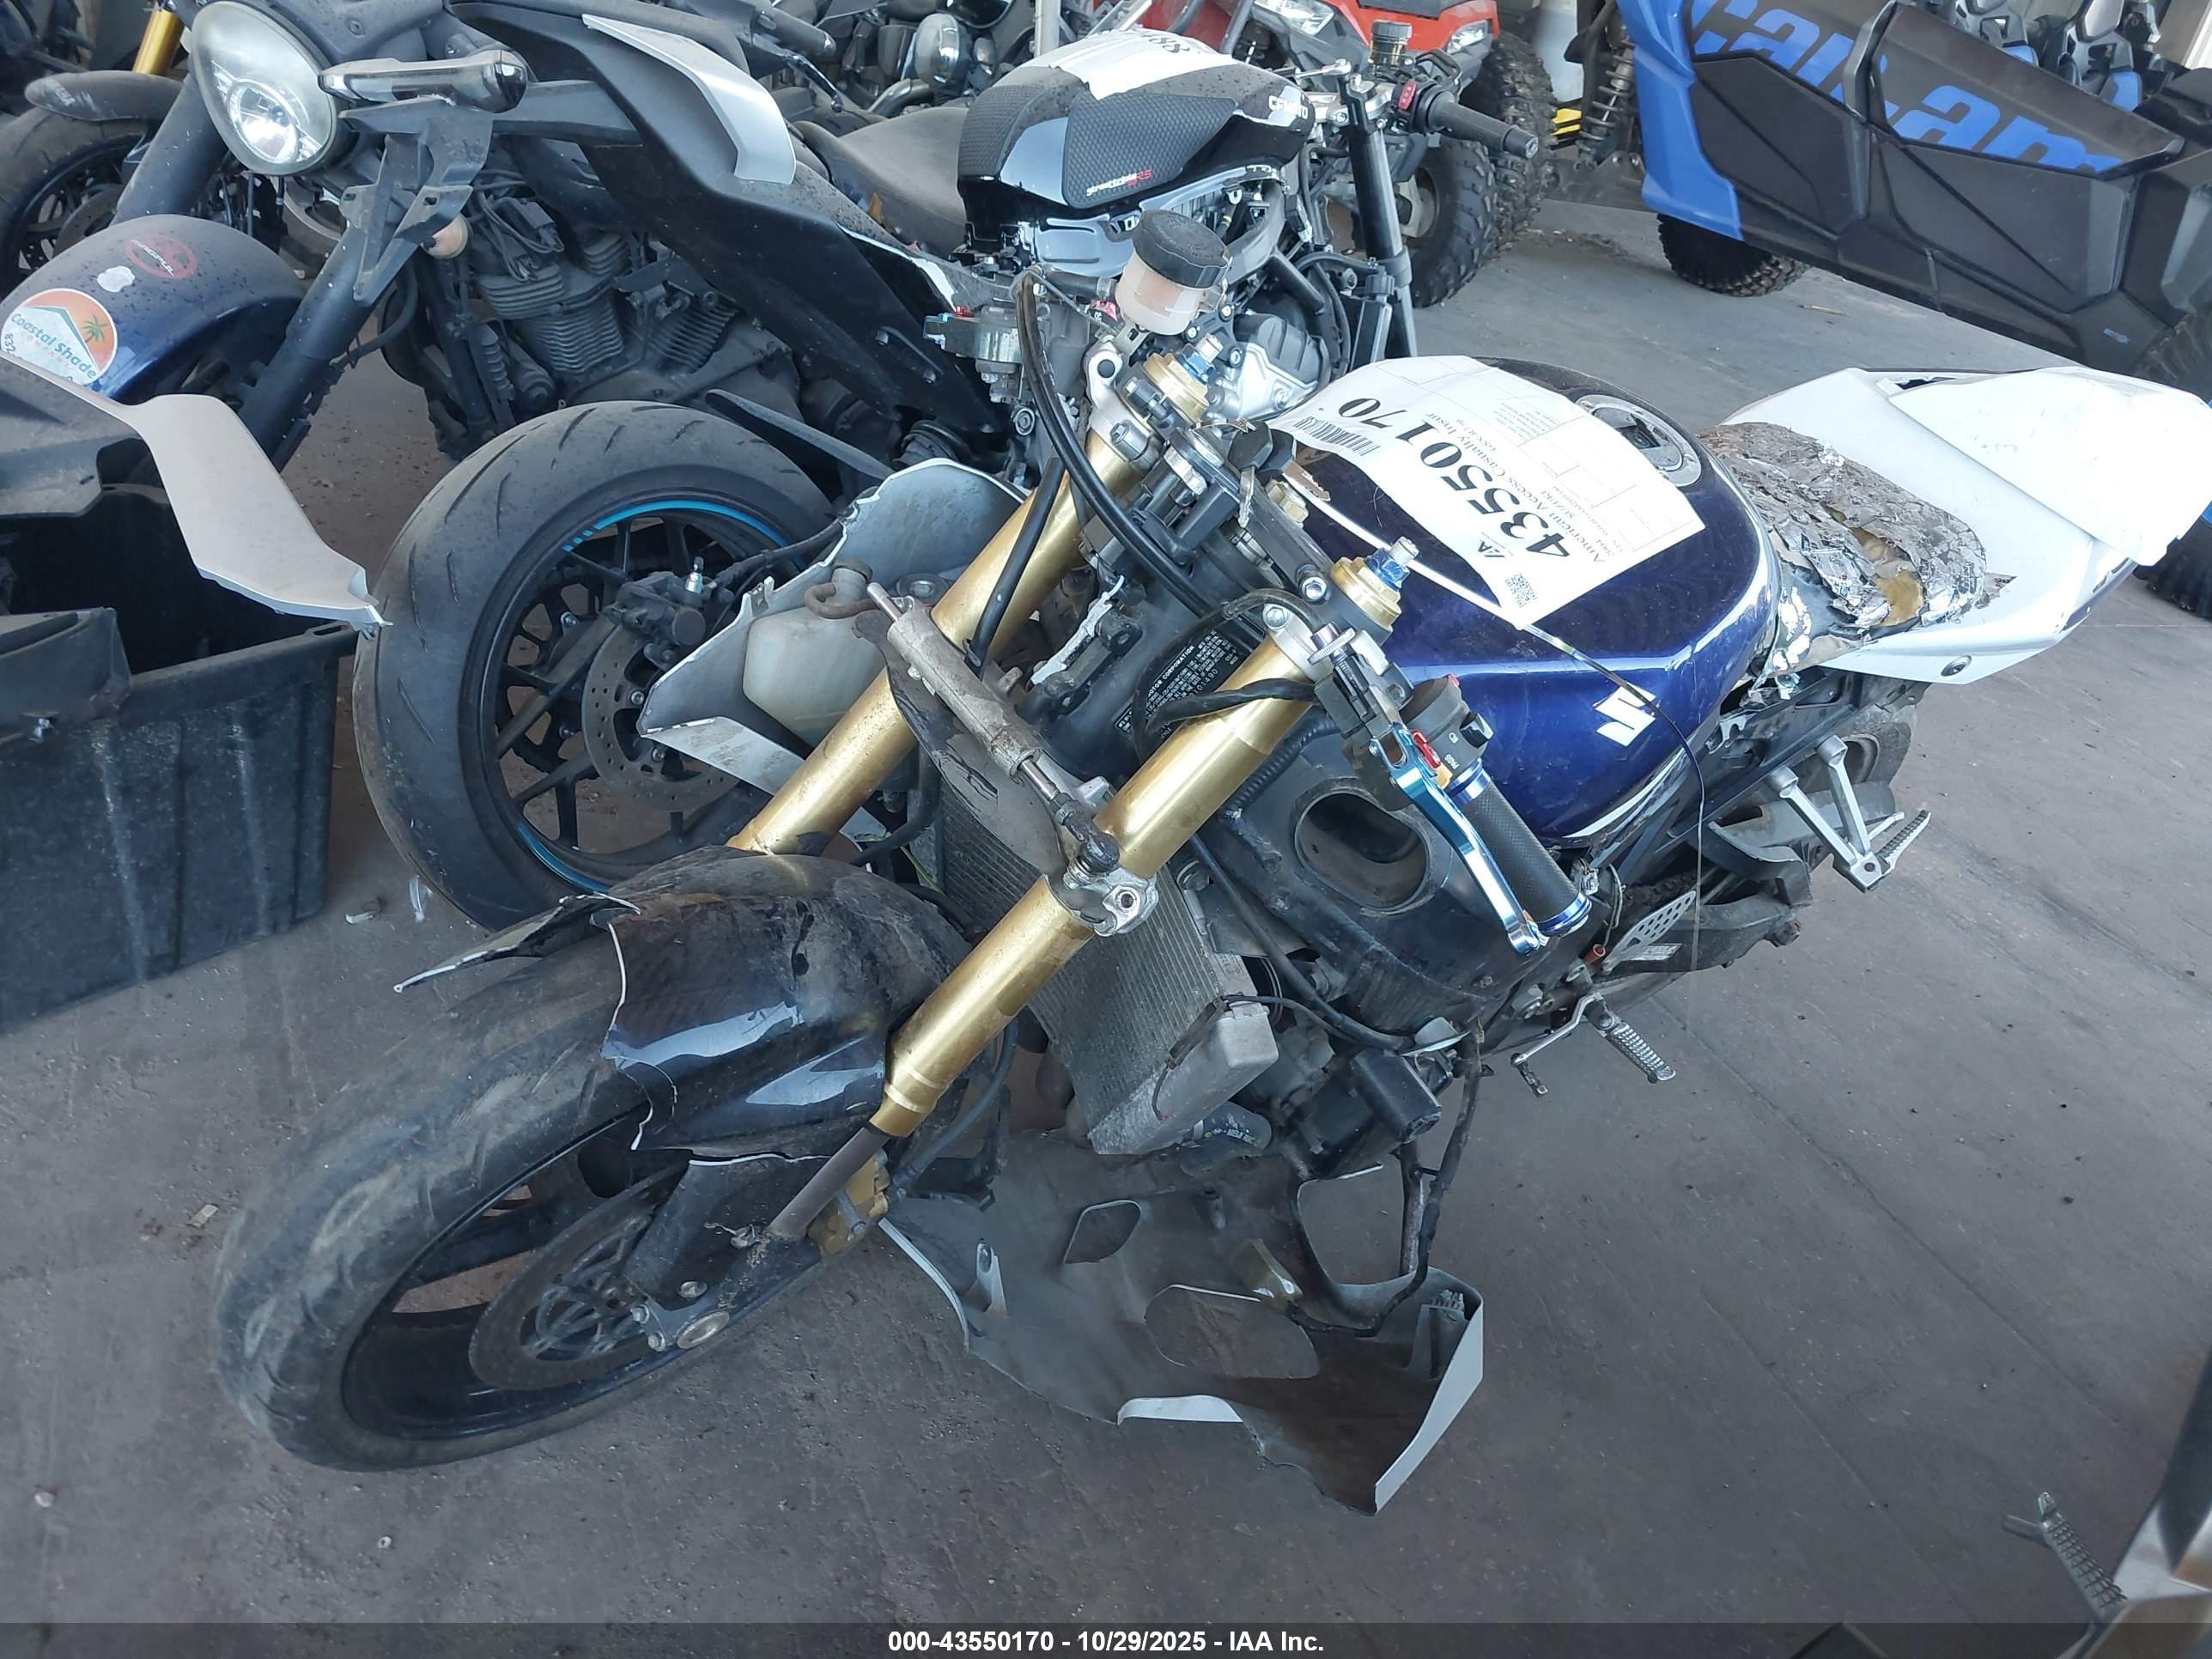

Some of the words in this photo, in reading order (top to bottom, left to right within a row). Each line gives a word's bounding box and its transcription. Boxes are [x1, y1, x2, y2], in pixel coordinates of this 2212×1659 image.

[10, 313, 57, 347] Coastal
[55, 342, 97, 380] Shade
[1456, 435, 1506, 477] Casualty
[1509, 477, 1548, 510] Access
[1549, 513, 1605, 562] American
[1162, 645, 1194, 679] CORPORATION
[1444, 754, 1460, 770] PASS
